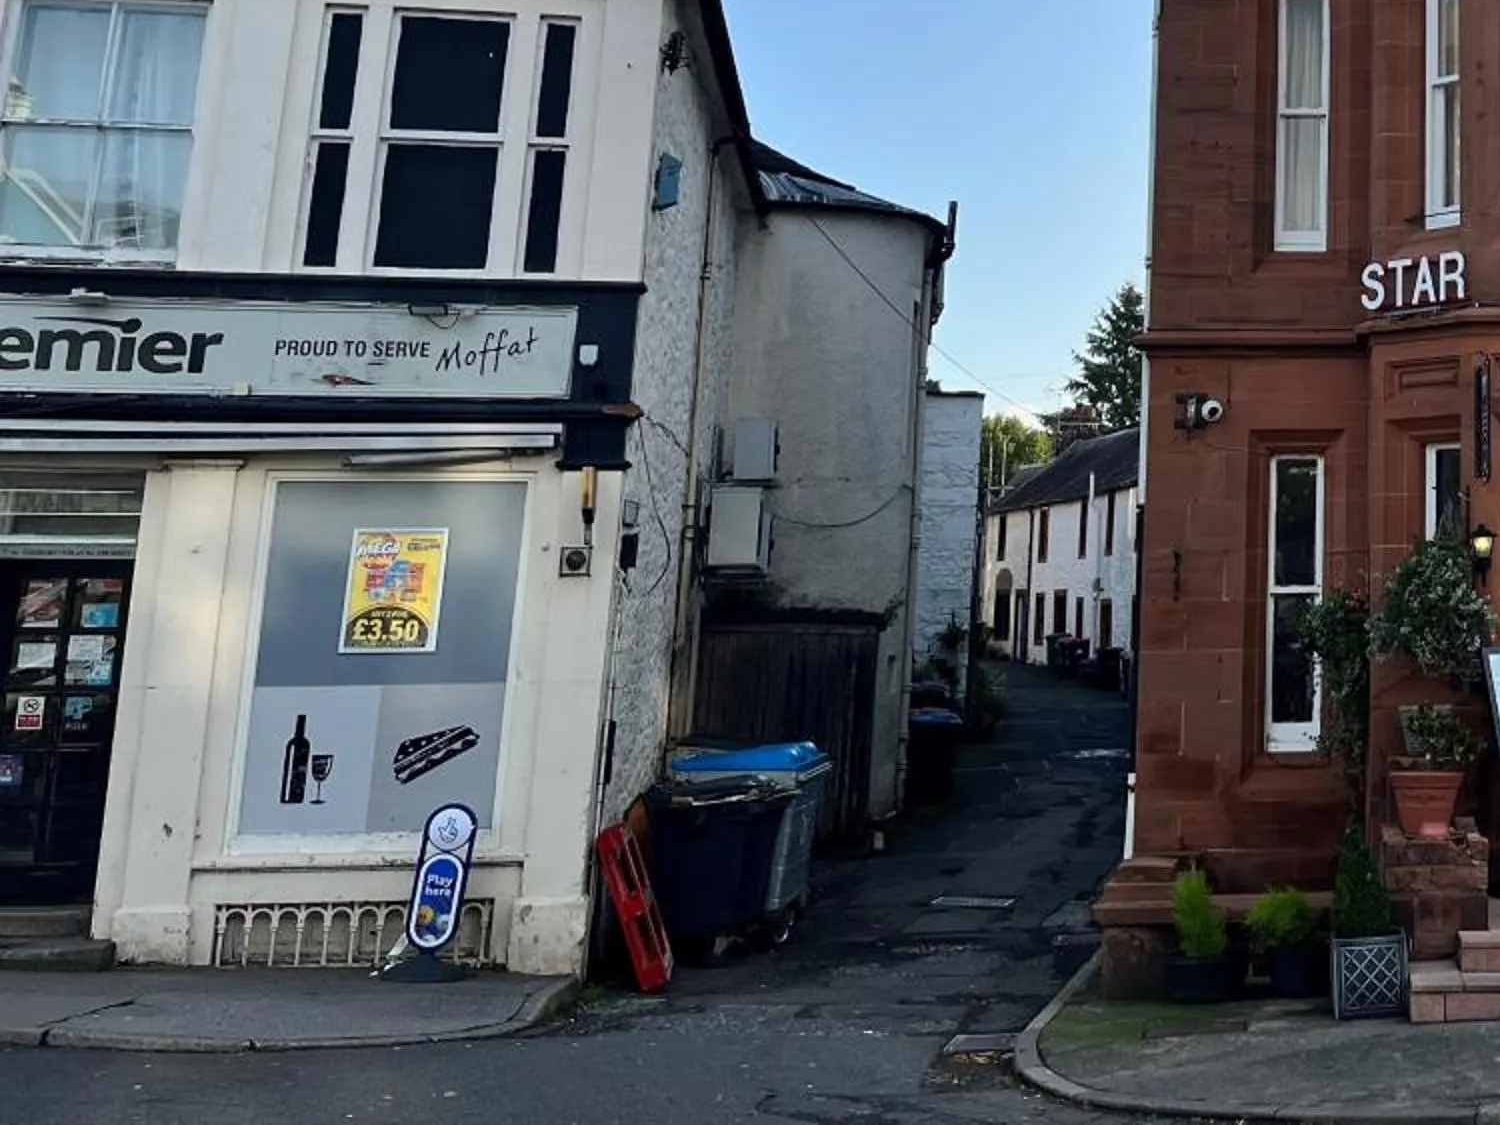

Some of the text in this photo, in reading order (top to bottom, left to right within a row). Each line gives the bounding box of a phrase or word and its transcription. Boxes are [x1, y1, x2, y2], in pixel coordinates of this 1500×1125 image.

[1361, 250, 1465, 311] STAR
[0, 317, 224, 375] emier
[275, 326, 539, 375] PROUD TO SERVE Moffat
[352, 618, 420, 641] £3.50
[425, 885, 451, 896] here
[426, 874, 453, 887] Play
